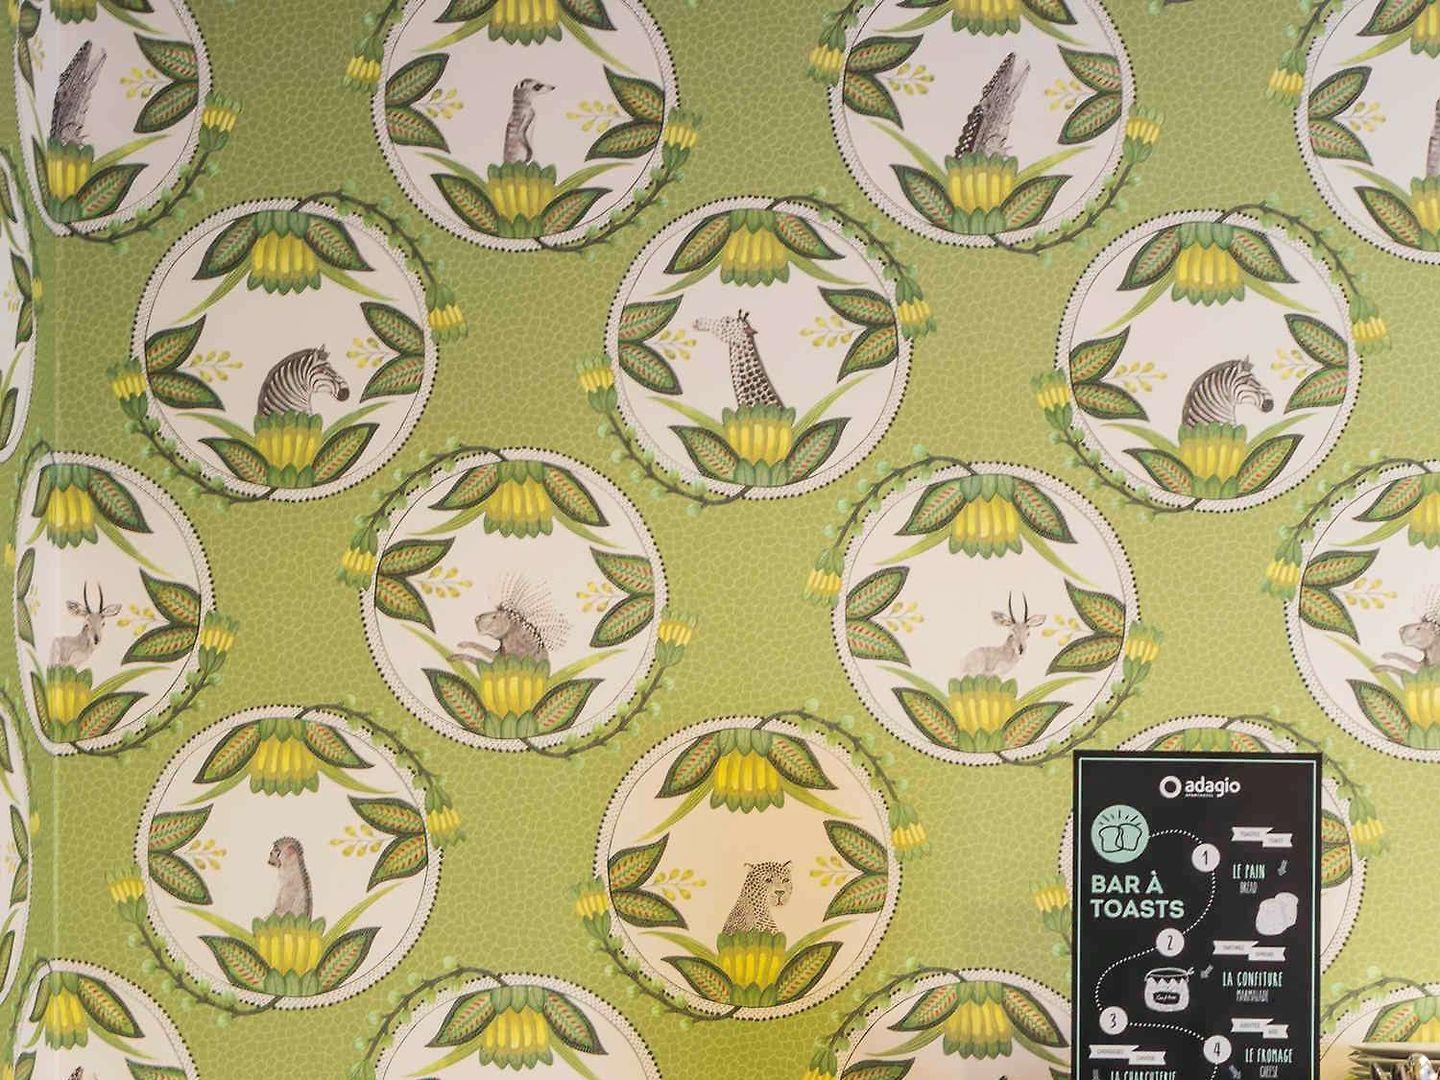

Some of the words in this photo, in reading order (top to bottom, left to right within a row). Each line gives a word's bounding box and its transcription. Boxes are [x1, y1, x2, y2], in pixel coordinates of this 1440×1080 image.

[1185, 776, 1241, 798] adagio
[1201, 850, 1208, 865] 1
[1233, 864, 1242, 879] LE
[1245, 864, 1265, 879] PAIN
[1091, 874, 1139, 893] BAR
[1090, 898, 1185, 919] TOASTS
[1167, 934, 1173, 950] 2
[1222, 971, 1234, 987] LA
[1237, 971, 1283, 988] CONFITURE
[1110, 1013, 1117, 1029] 3
[1213, 1042, 1220, 1057] 4
[1245, 1048, 1255, 1063] LE
[1257, 1048, 1293, 1064] FROMAGE
